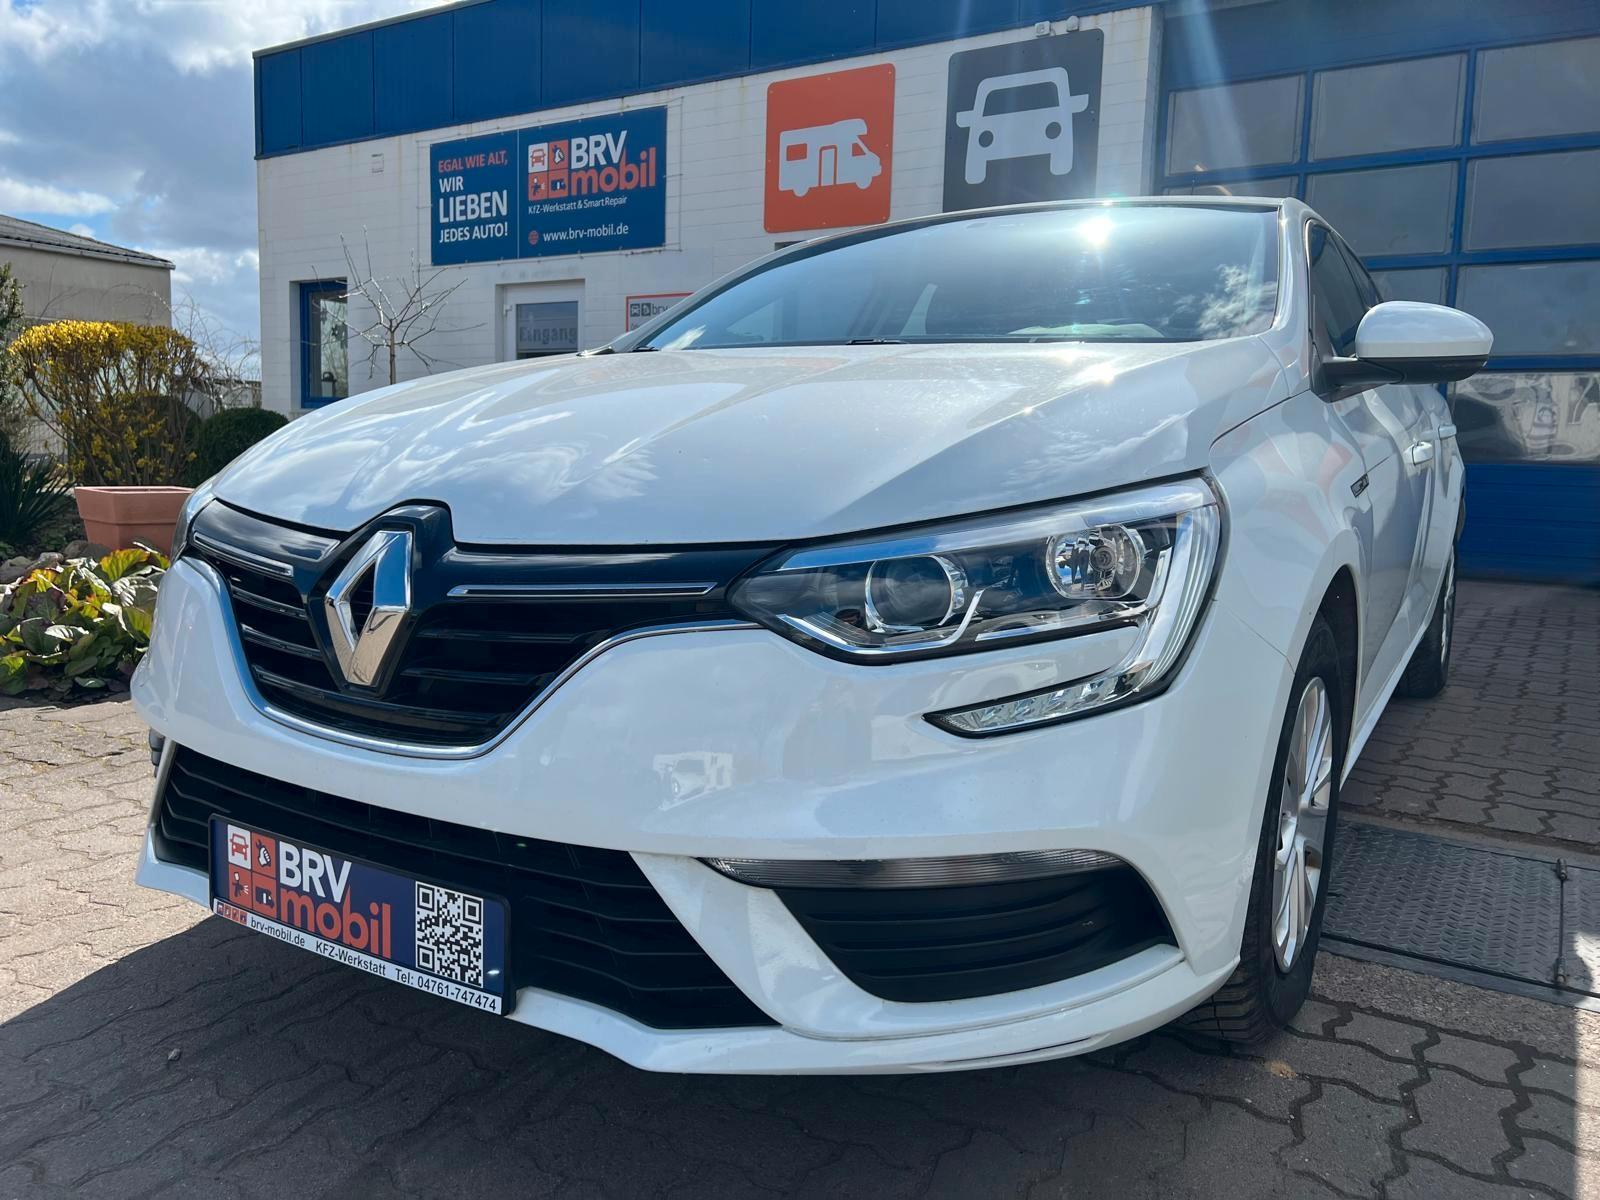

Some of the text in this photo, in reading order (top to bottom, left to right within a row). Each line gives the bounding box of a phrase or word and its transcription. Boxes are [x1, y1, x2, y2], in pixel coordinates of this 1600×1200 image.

[438, 150, 508, 173] EGAL WIE ALT,
[571, 130, 628, 169] BRV
[439, 175, 464, 193] WIR
[571, 147, 657, 197] mobil
[439, 189, 508, 224] LIEBEN
[577, 199, 583, 209] &
[604, 196, 628, 207] Repair
[439, 221, 508, 244] JEDES AUTO!
[543, 222, 629, 242] www.brv-mobil.de
[519, 326, 578, 345] Eingang
[279, 840, 352, 904] BRV
[280, 885, 391, 959] mobil
[250, 916, 497, 1012] brv-mobil.de KFZ-Werkstatt Tel: 04761-747474
